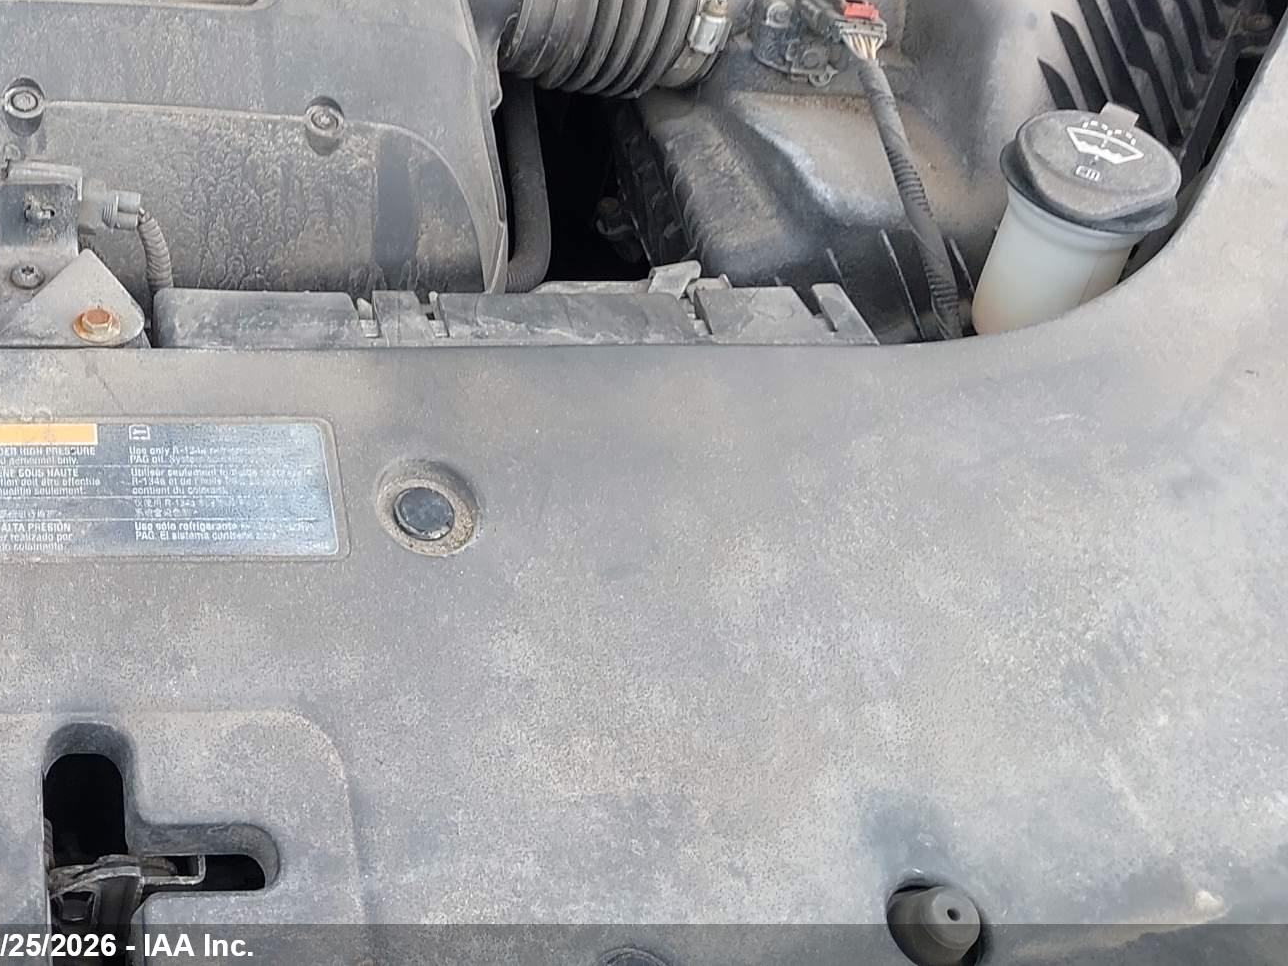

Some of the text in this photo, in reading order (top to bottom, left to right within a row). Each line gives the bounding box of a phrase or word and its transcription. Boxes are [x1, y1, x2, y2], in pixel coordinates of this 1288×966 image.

[20, 446, 44, 456] HIGH
[45, 446, 96, 456] PRESSURE
[149, 446, 170, 457] only
[18, 467, 45, 478] SOUS
[46, 467, 79, 477] HAUTE
[1, 521, 25, 532] ALTA
